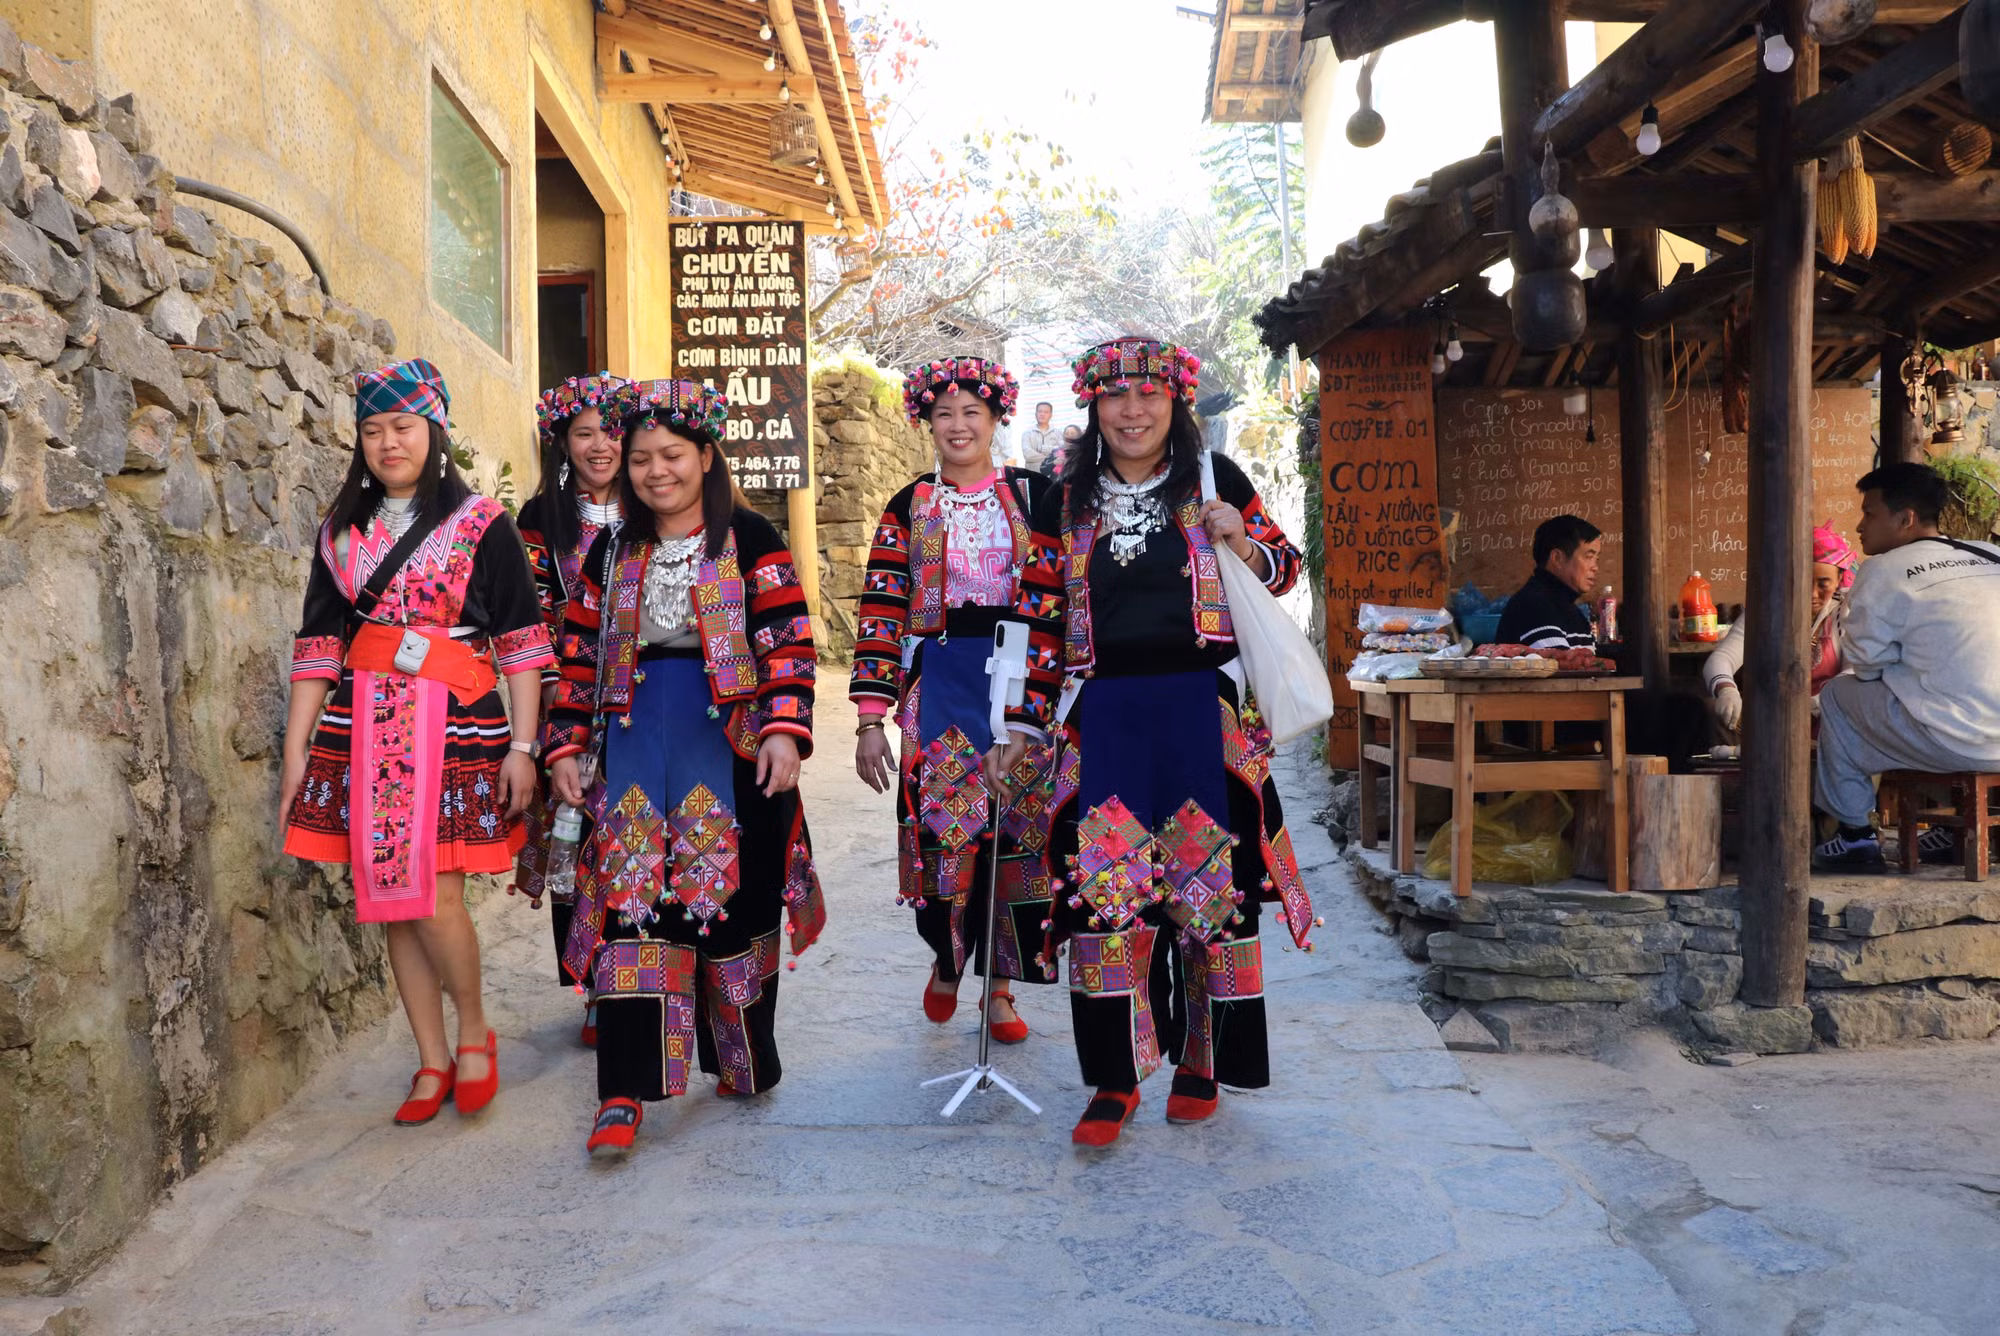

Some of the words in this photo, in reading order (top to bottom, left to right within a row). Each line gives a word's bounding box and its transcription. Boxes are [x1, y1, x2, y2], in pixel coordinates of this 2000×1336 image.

[717, 225, 739, 246] PA
[682, 277, 708, 293] PHỤ
[711, 277, 730, 293] VỤ
[734, 273, 754, 290] ĂN
[732, 290, 749, 307] ĂN
[751, 290, 775, 307] DÂN
[778, 289, 800, 309] TỘC
[687, 315, 737, 336] CƠM
[745, 311, 785, 338] ĐẶT
[678, 347, 715, 367] CƠM
[720, 344, 760, 366] BÌNH
[766, 342, 801, 366] DÂN
[743, 474, 767, 488] 261
[774, 474, 800, 488] 771
[1327, 496, 1359, 524] LẨU
[1907, 564, 1926, 579] AN
[1389, 581, 1434, 606] grilled
